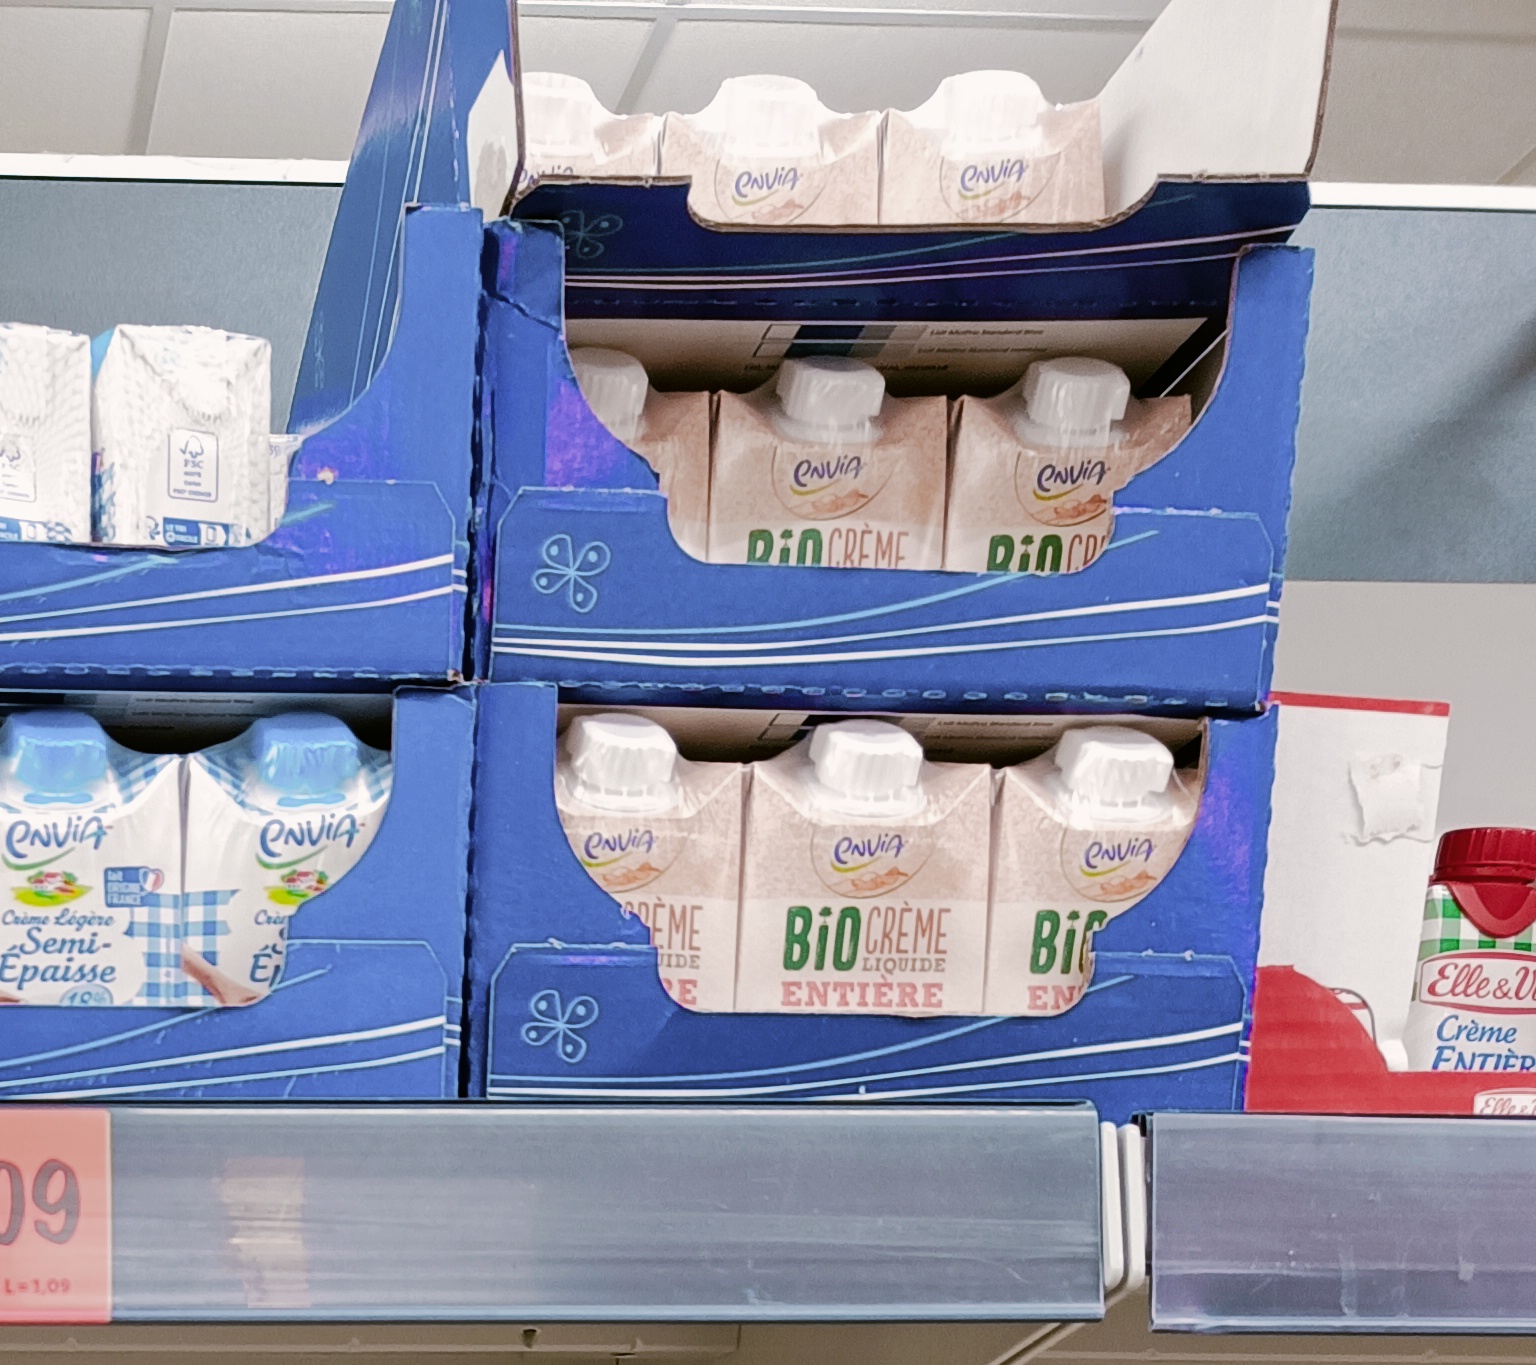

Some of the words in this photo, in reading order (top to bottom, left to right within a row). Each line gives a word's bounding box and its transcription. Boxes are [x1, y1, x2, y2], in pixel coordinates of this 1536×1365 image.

[2, 909, 51, 926] Crème
[54, 908, 116, 932] Légère
[864, 901, 952, 955] CRÈME
[18, 926, 113, 956] Semi-
[862, 957, 946, 974] LIQUIDE
[780, 974, 944, 1009] ENTIÈRE
[1436, 1014, 1518, 1044] Crème
